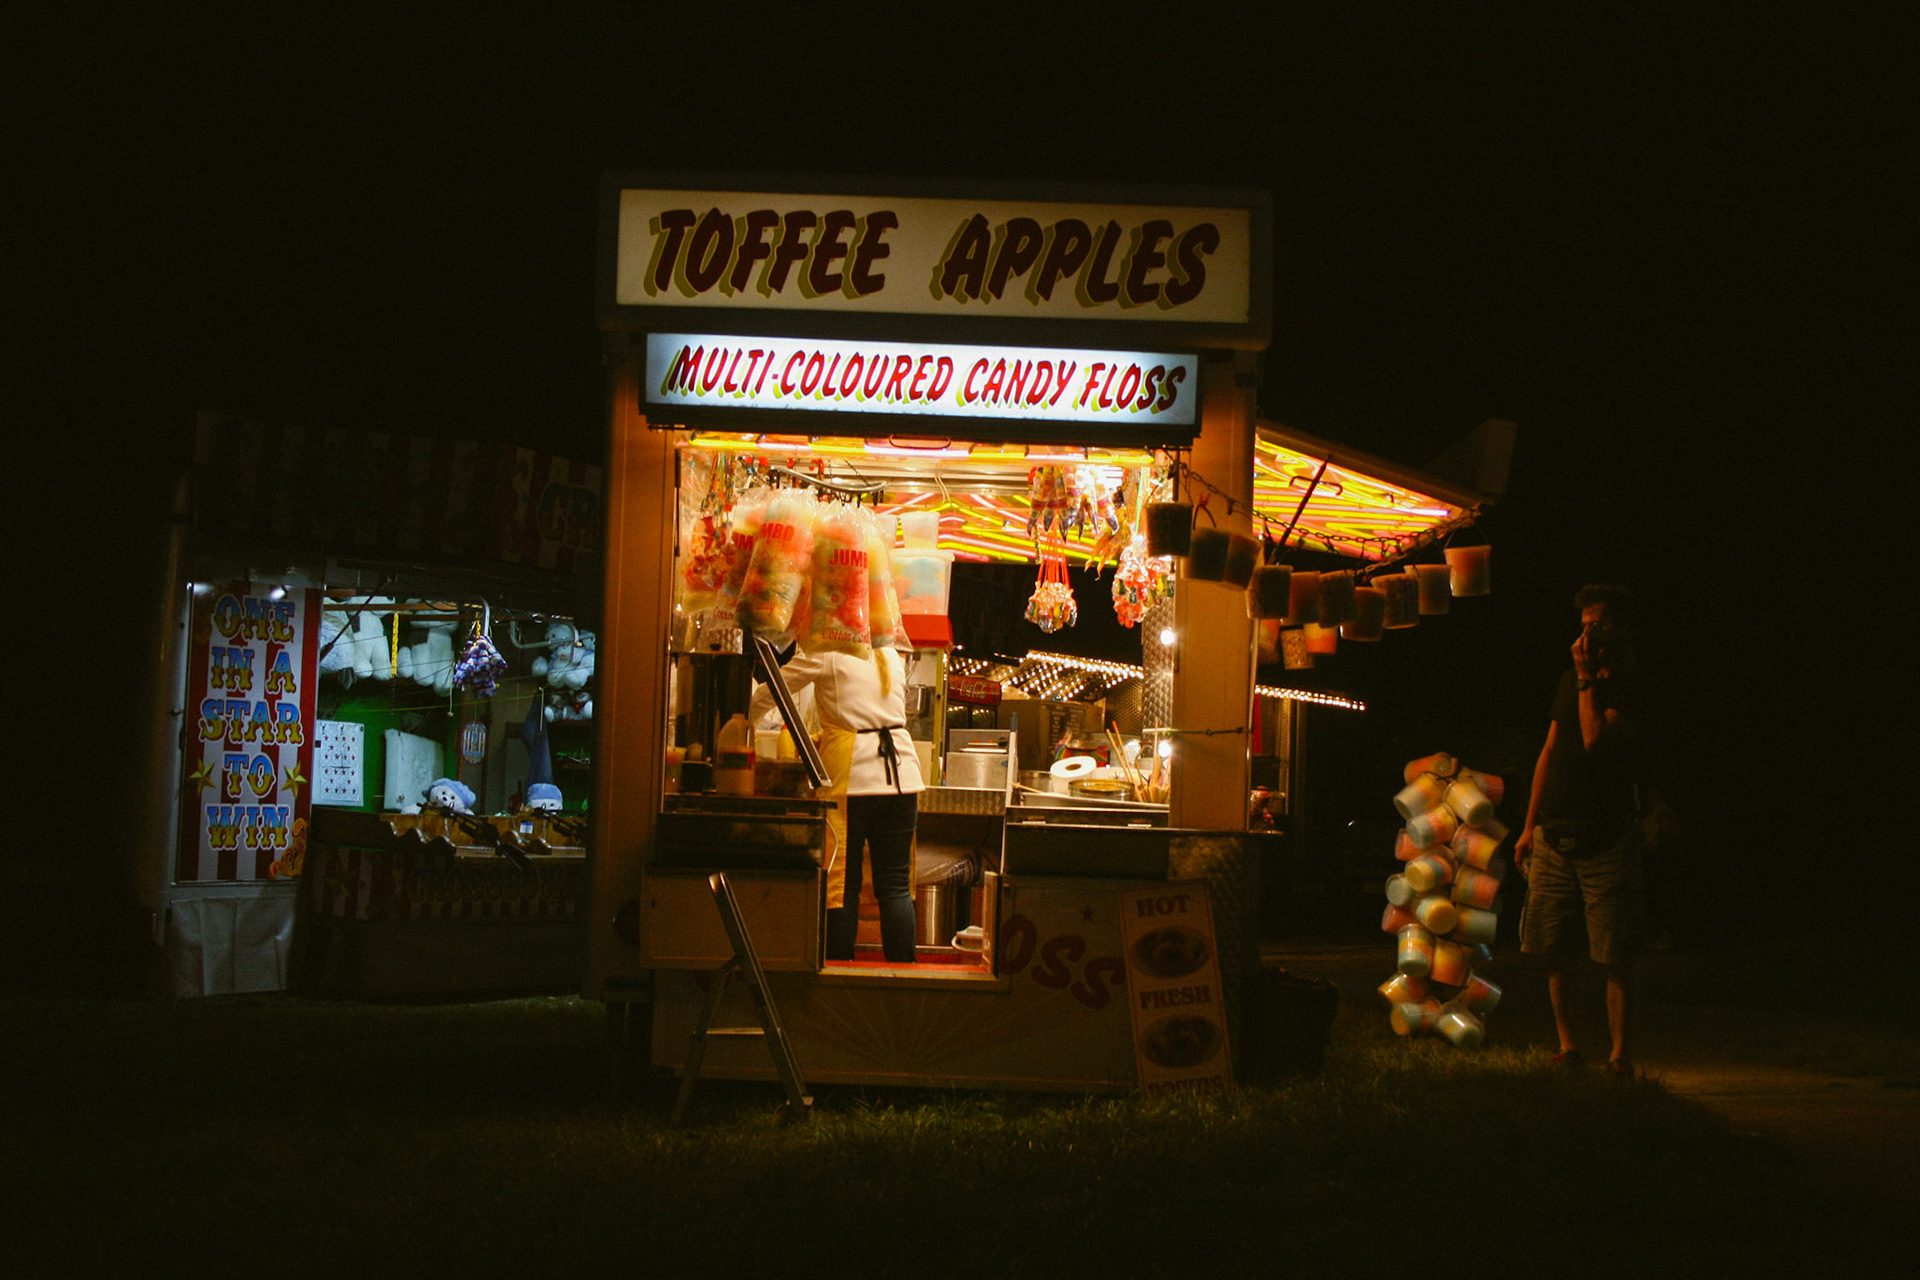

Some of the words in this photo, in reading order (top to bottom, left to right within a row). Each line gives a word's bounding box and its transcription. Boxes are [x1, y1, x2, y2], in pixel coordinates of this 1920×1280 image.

[646, 207, 899, 299] TOFFEE
[931, 213, 1220, 309] APPLES
[662, 344, 953, 404] MULTI-COLOURED
[958, 357, 1077, 408] CANDY
[1074, 361, 1187, 414] FLOSS
[212, 596, 294, 642] ONE
[210, 647, 254, 690] IN
[266, 651, 297, 693] A
[199, 699, 303, 745] STAR
[223, 754, 275, 797] TO
[206, 805, 289, 850] WIN
[1137, 894, 1190, 917] HOT
[1140, 985, 1211, 1009] FRESH
